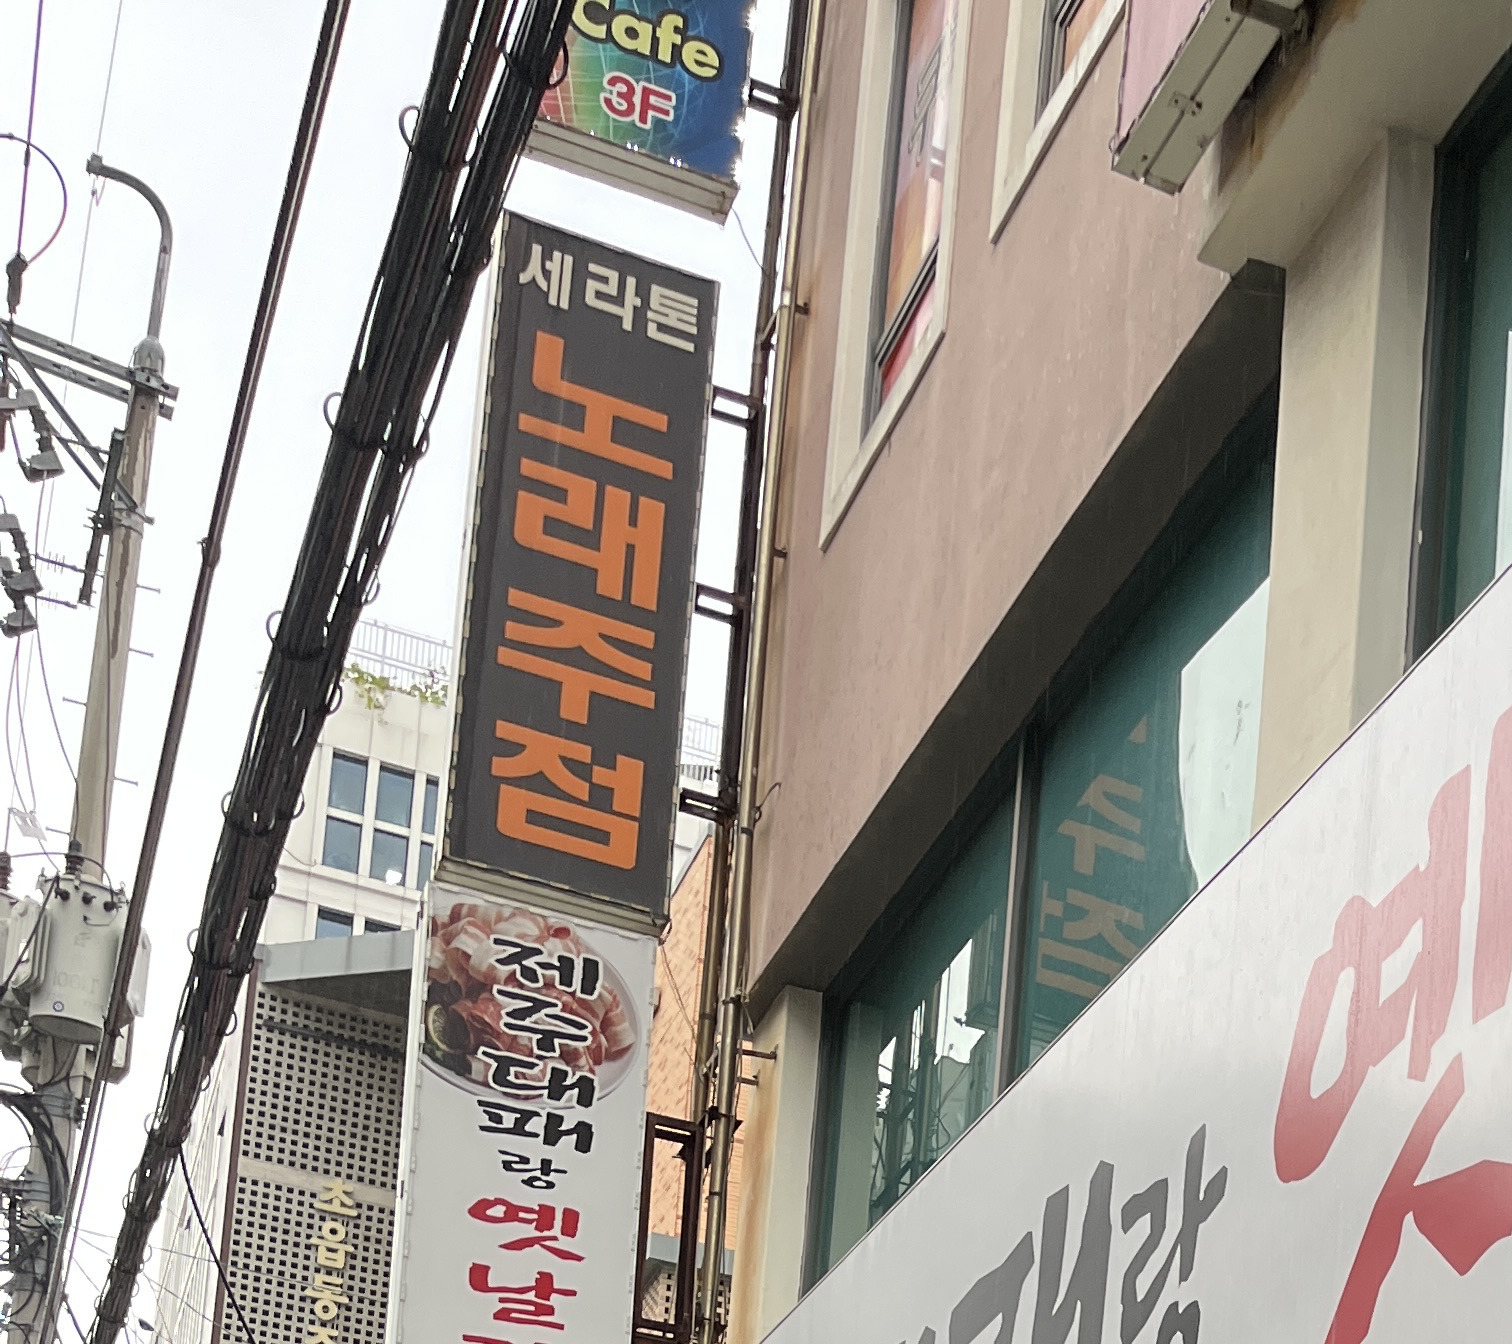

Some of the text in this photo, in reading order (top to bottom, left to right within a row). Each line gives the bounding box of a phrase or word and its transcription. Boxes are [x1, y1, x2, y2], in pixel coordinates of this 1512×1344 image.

[570, 0, 722, 80] Cafe
[600, 70, 676, 129] 3F
[519, 242, 700, 354] 세라톤
[490, 329, 676, 872] 노래주점
[477, 937, 603, 1190] 제주대패랑
